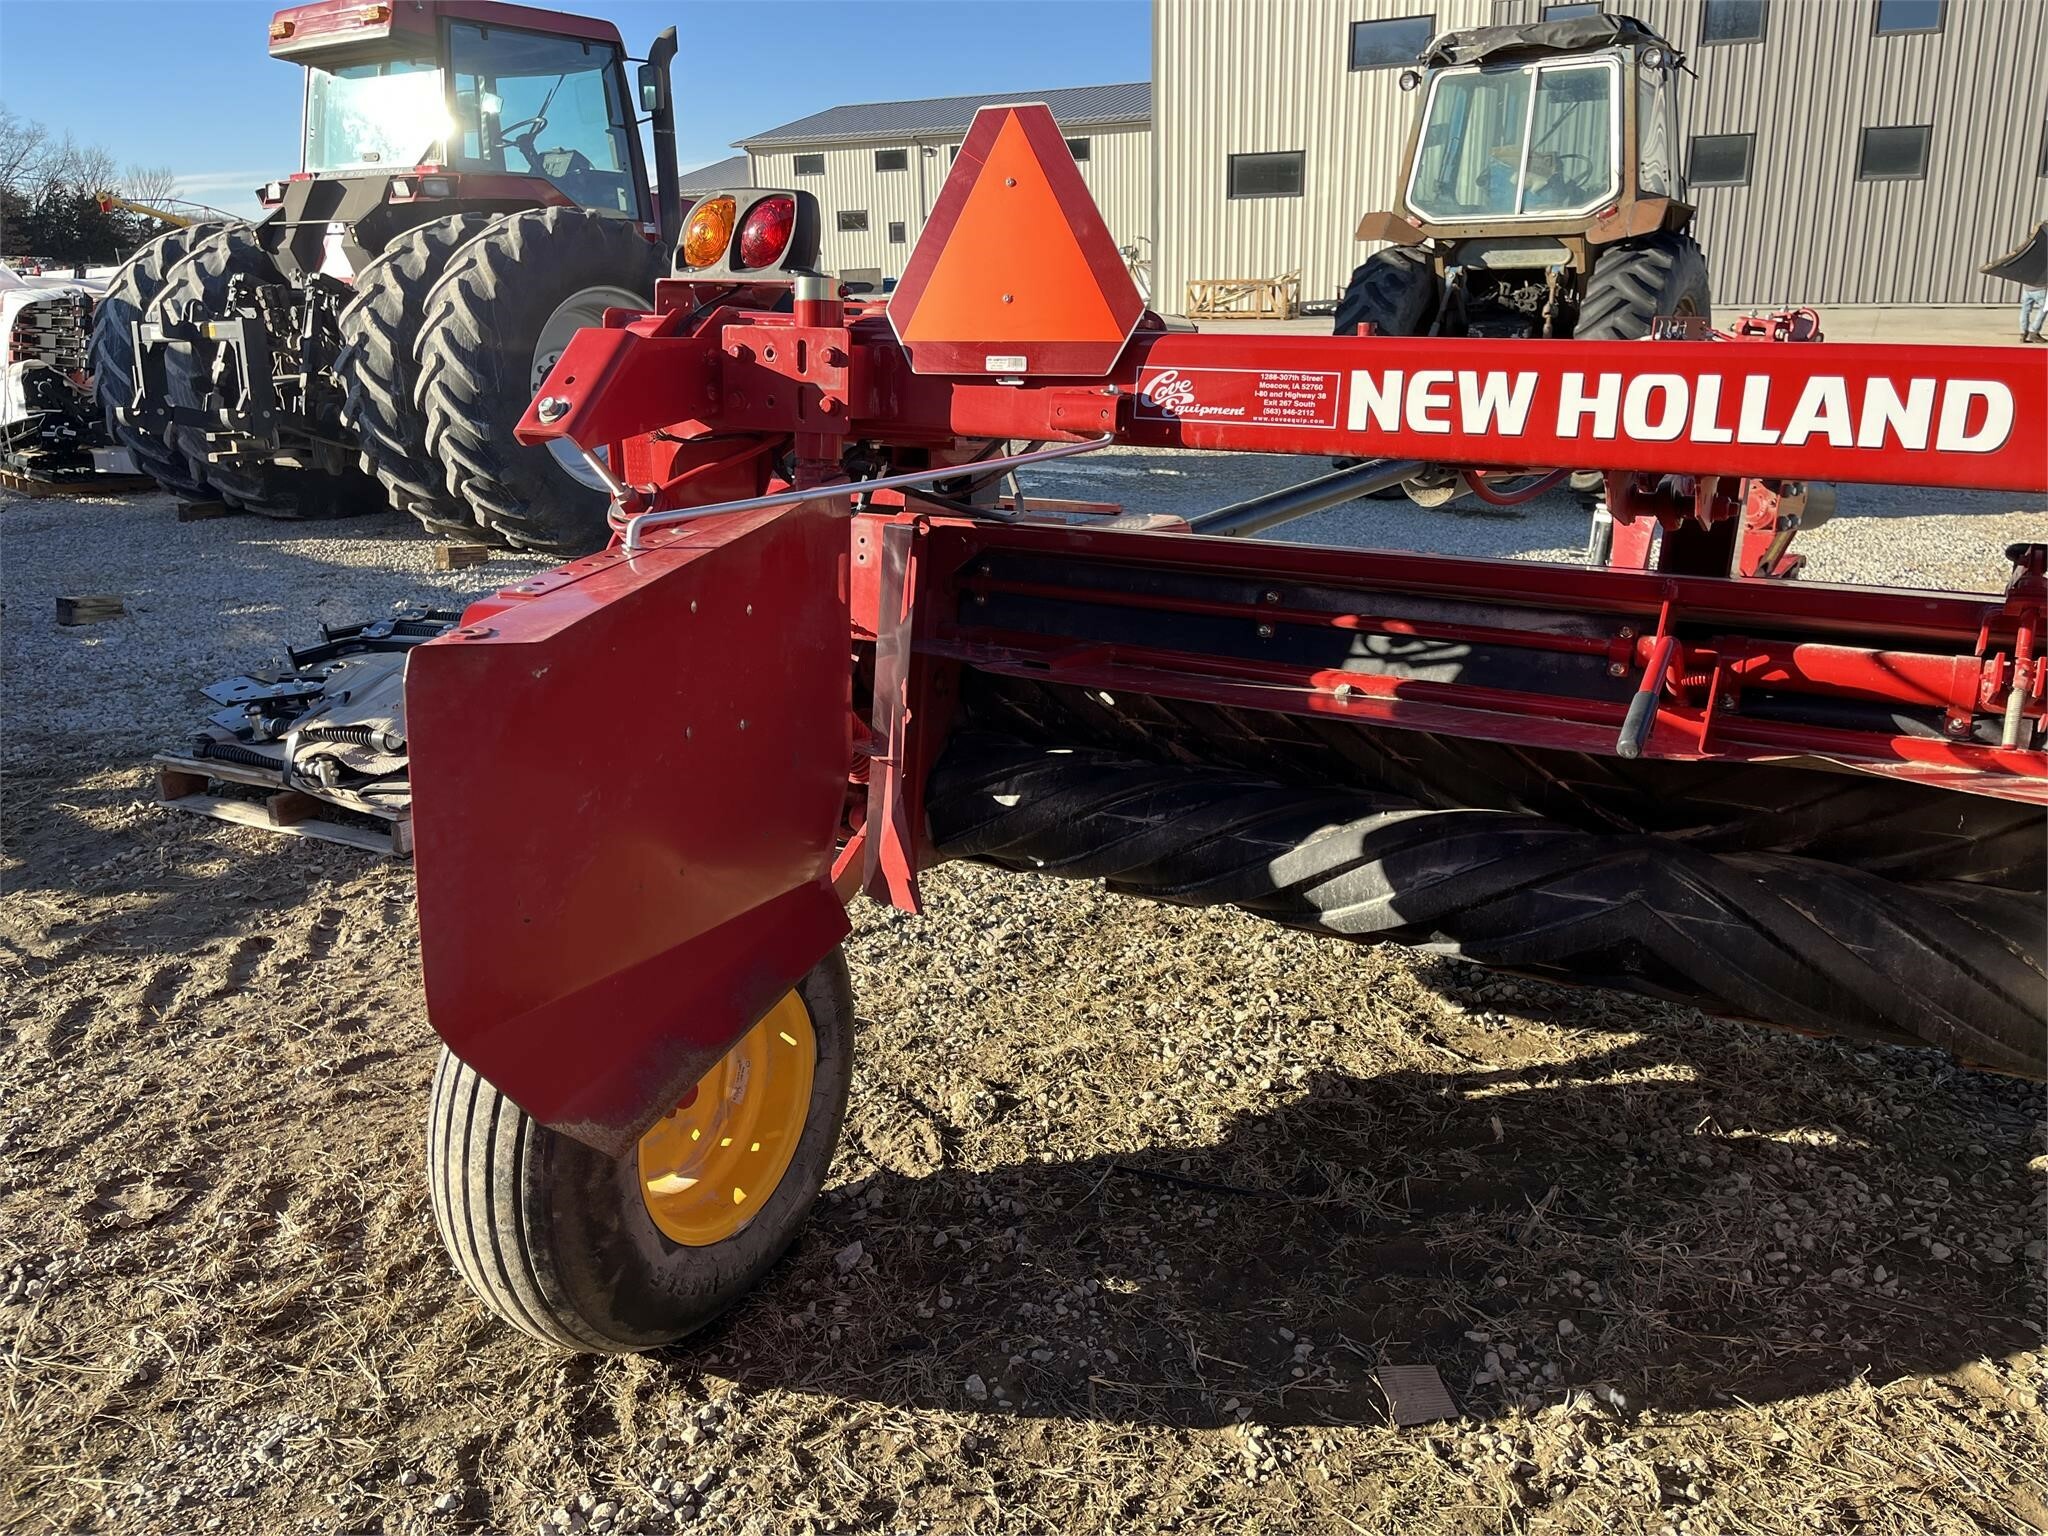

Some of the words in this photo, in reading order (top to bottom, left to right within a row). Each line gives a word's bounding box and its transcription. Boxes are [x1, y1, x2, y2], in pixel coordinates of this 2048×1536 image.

[1141, 370, 1195, 407] Cove
[1259, 382, 1290, 390] Moscow,
[1284, 391, 1316, 401] Highway
[1161, 397, 1245, 417] Equipment
[1263, 399, 1278, 407] Exit
[1263, 408, 1281, 417] (563)
[1348, 369, 1538, 435] NEW
[1556, 373, 2016, 453] HOLLAND
[1252, 416, 1325, 424] www.coveequip.com
